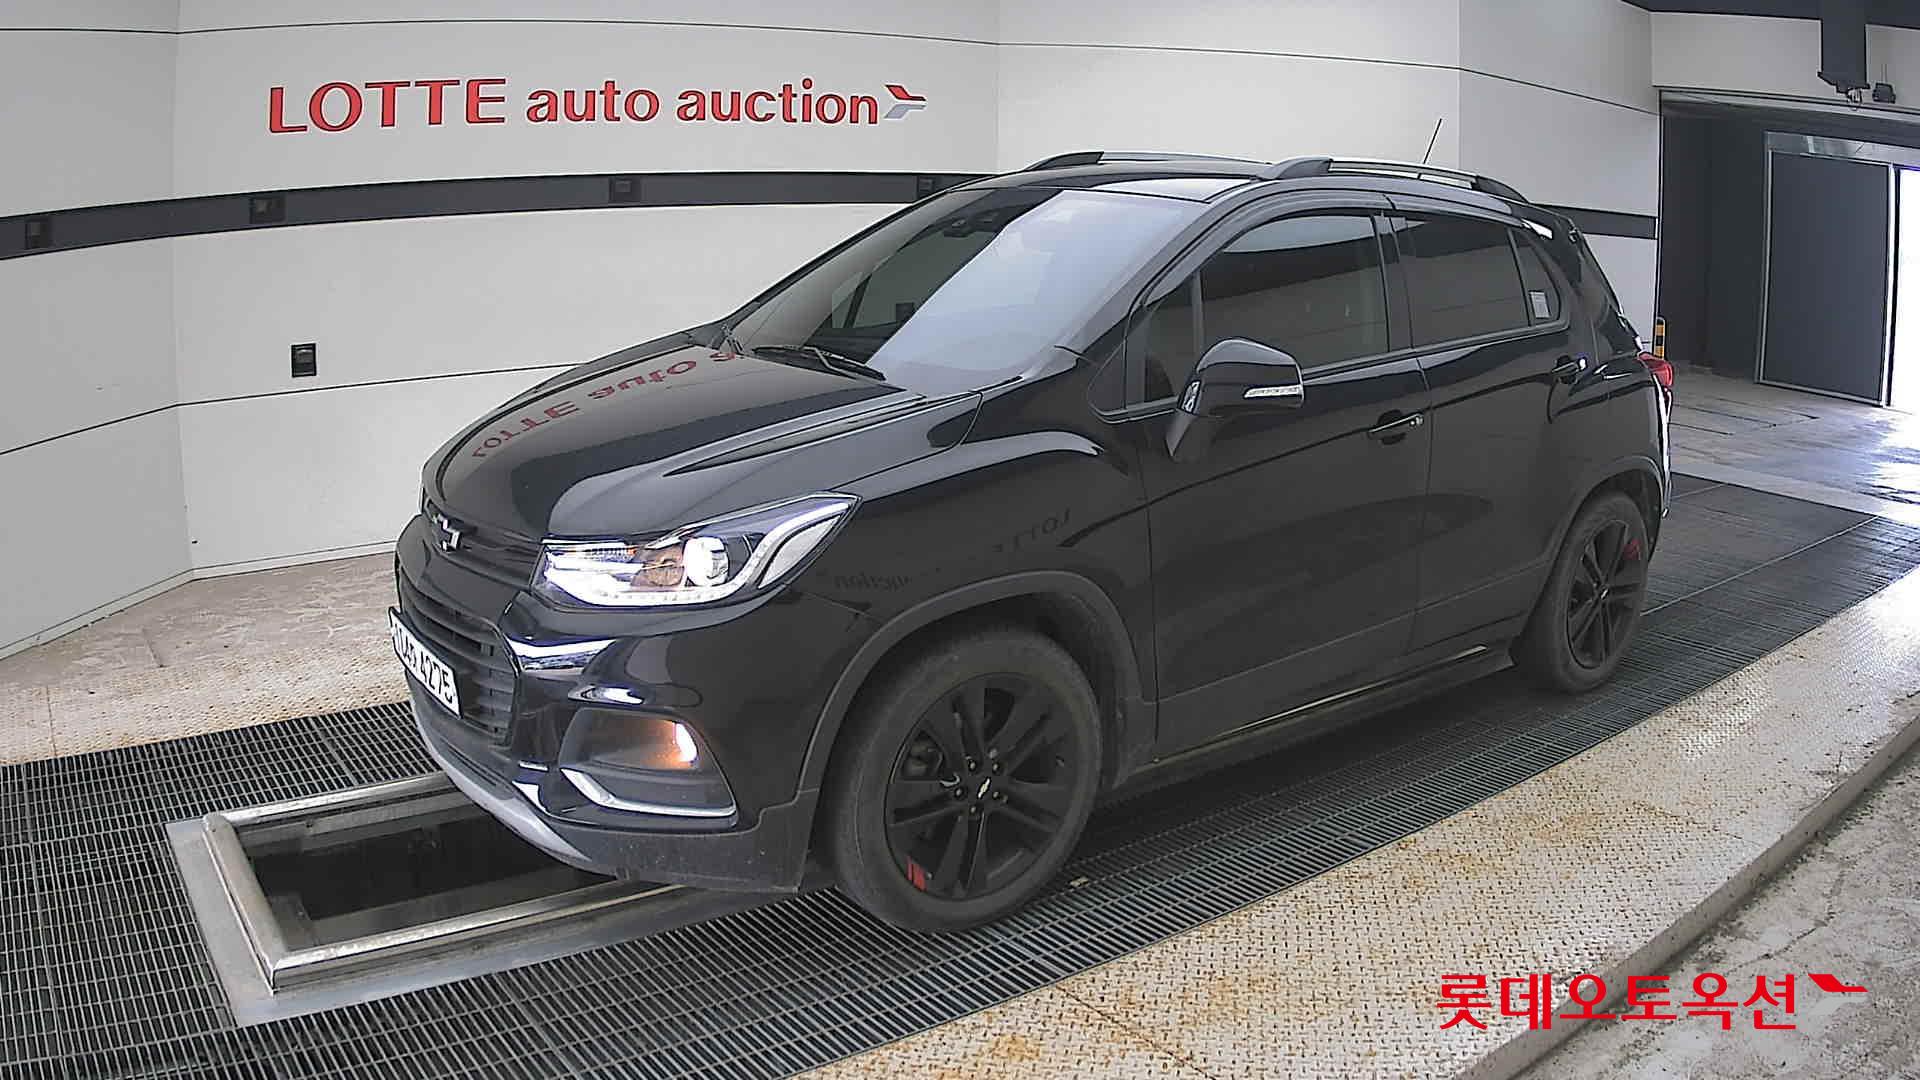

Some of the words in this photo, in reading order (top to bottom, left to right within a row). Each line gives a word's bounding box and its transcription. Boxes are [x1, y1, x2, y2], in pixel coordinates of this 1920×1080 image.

[268, 78, 507, 134] LOTTE
[526, 80, 660, 123] auto
[676, 77, 880, 125] auction
[420, 650, 454, 705] 4275
